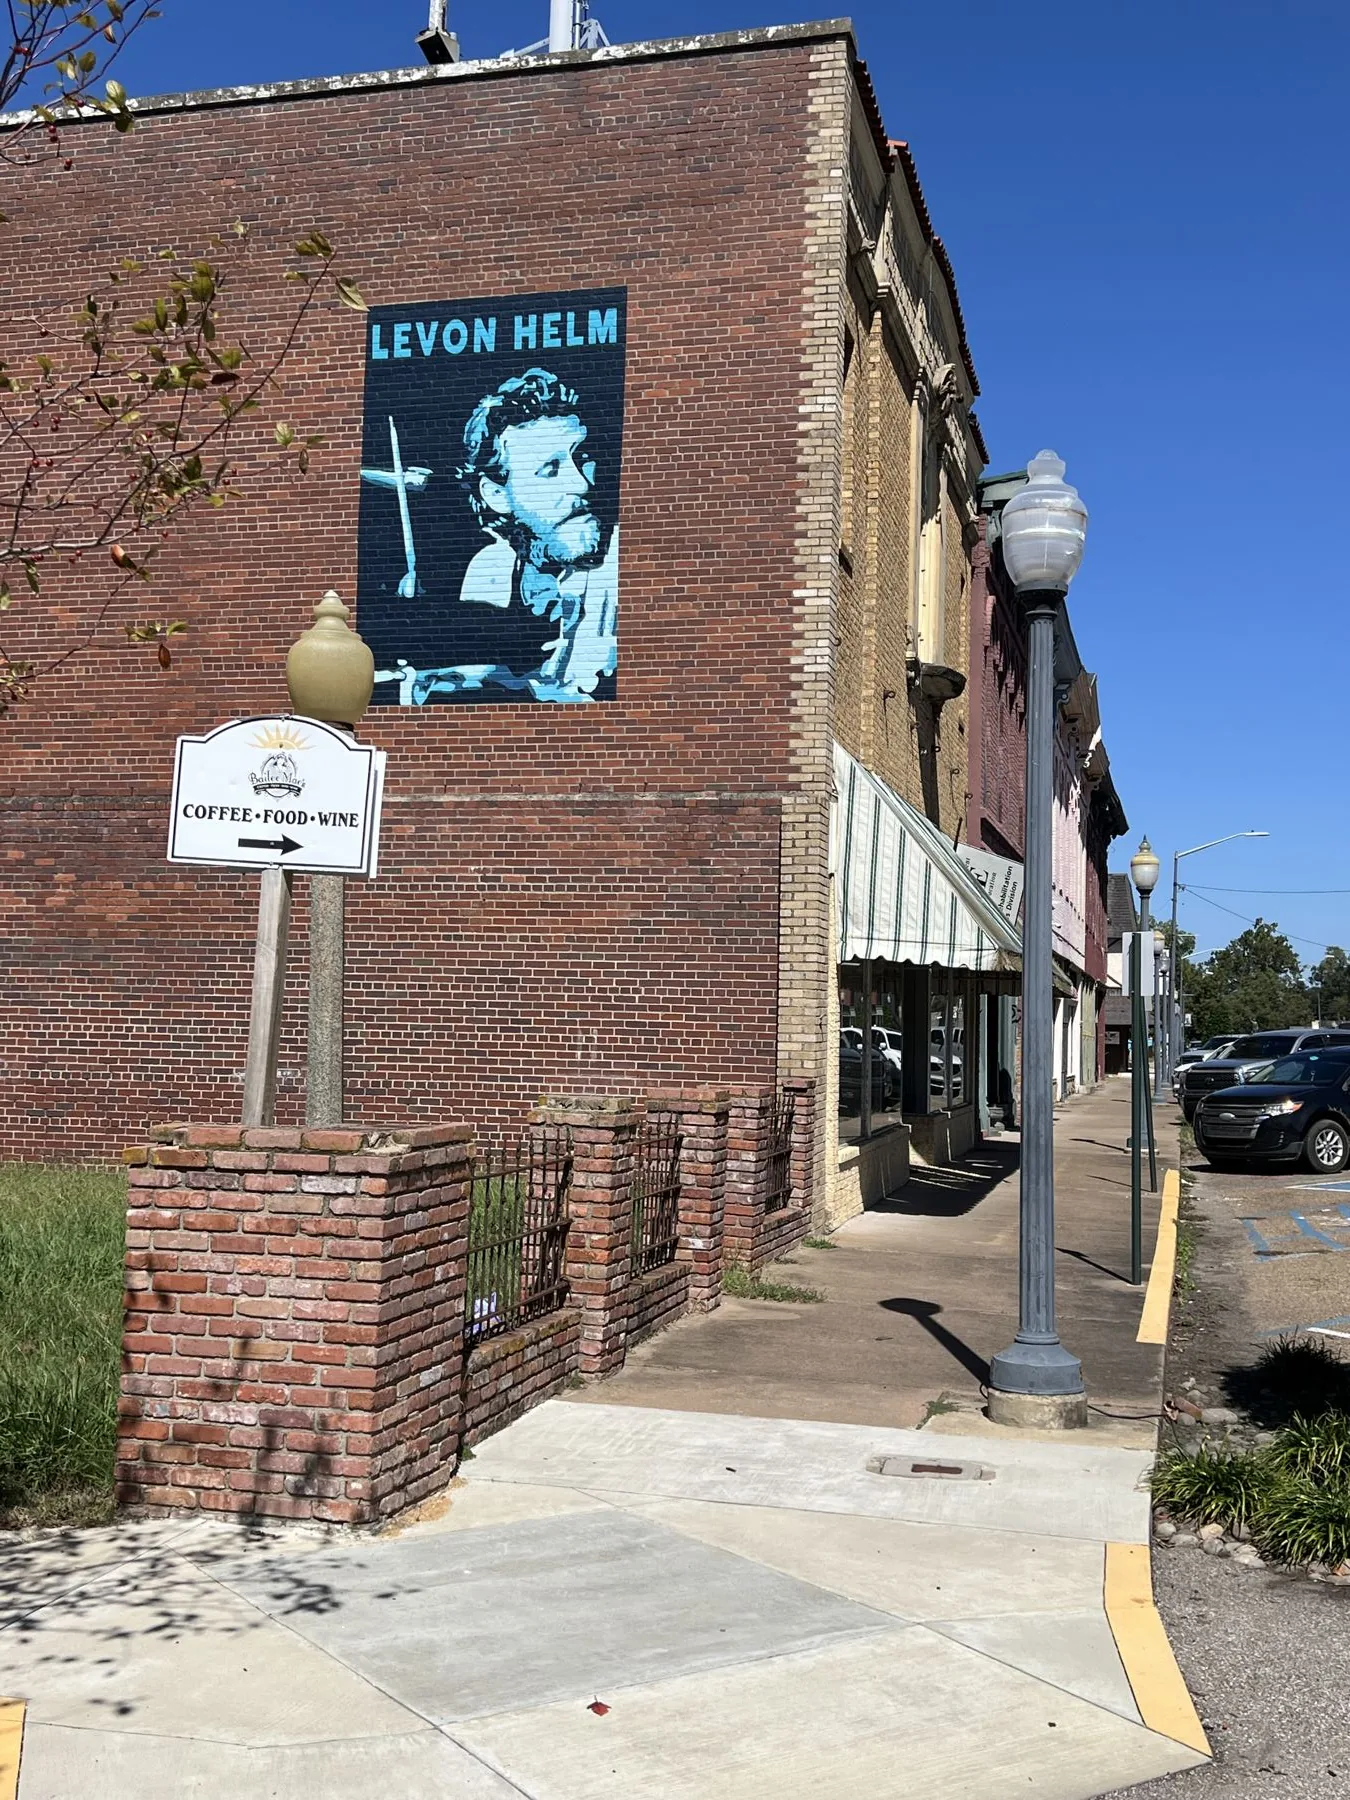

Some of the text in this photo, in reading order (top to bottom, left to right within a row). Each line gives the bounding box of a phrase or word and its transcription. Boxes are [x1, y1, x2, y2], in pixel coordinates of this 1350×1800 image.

[371, 307, 618, 360] LEVON HELM
[182, 804, 359, 828] COFFEE FOOD WINE
[998, 866, 1013, 909] habilitation
[1006, 881, 1017, 910] Division
